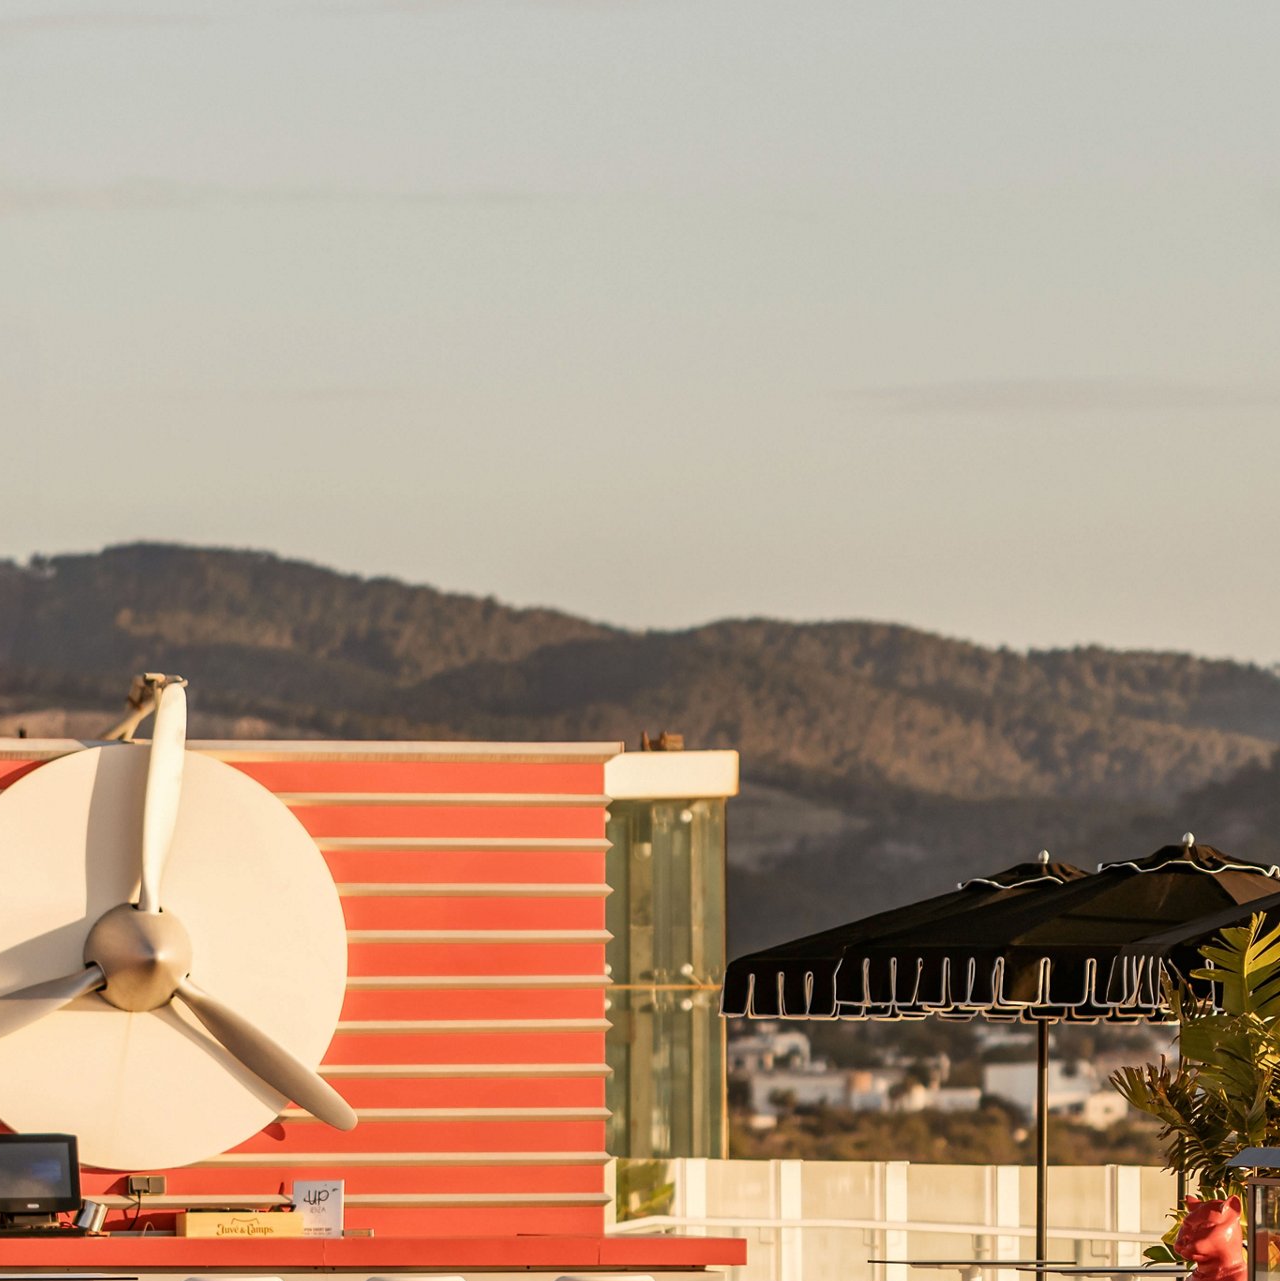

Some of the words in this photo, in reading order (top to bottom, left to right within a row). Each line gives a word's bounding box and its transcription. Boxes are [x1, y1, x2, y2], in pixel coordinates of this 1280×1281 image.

[216, 1223, 239, 1236] Juvé
[239, 1226, 246, 1234] &
[247, 1223, 274, 1236] Camps
